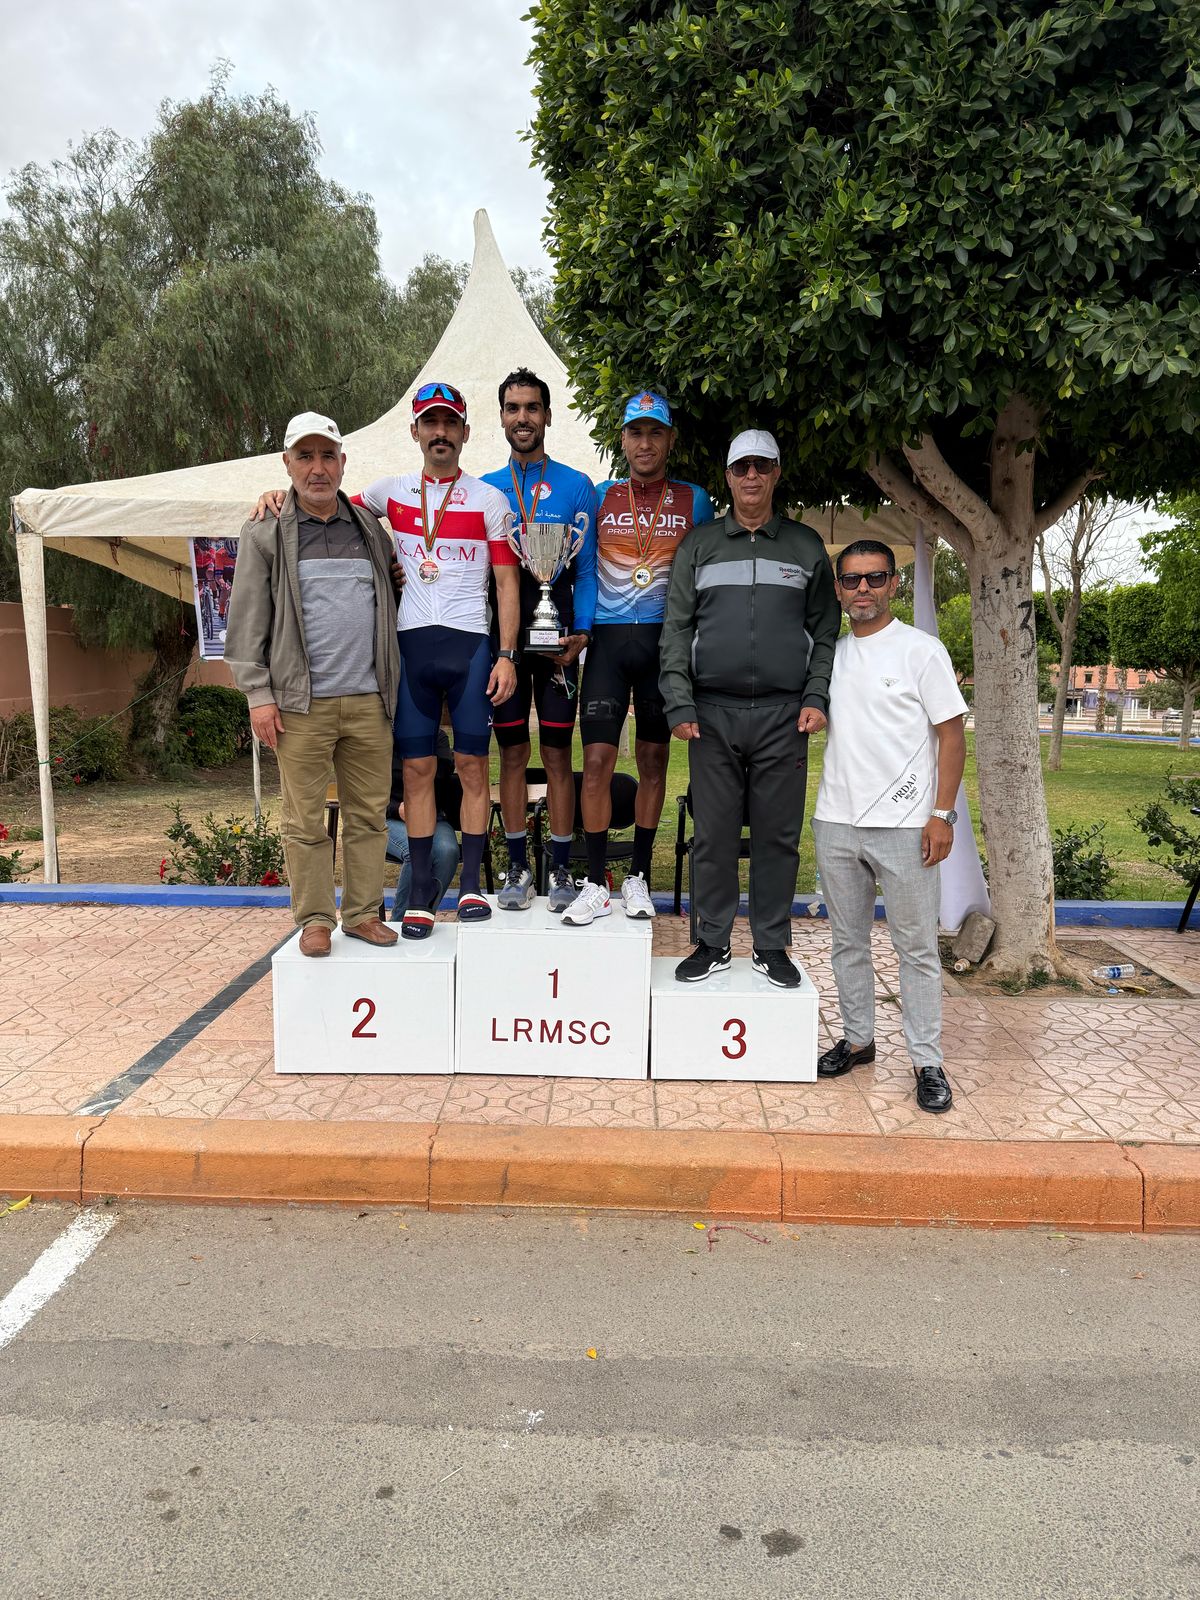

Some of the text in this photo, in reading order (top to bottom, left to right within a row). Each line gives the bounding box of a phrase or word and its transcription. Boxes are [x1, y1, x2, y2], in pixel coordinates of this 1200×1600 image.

[600, 512, 687, 529] AGADIR
[547, 968, 559, 999] 1
[351, 997, 377, 1038] 2
[491, 1017, 611, 1046] LRMSC
[721, 1018, 747, 1060] 3
